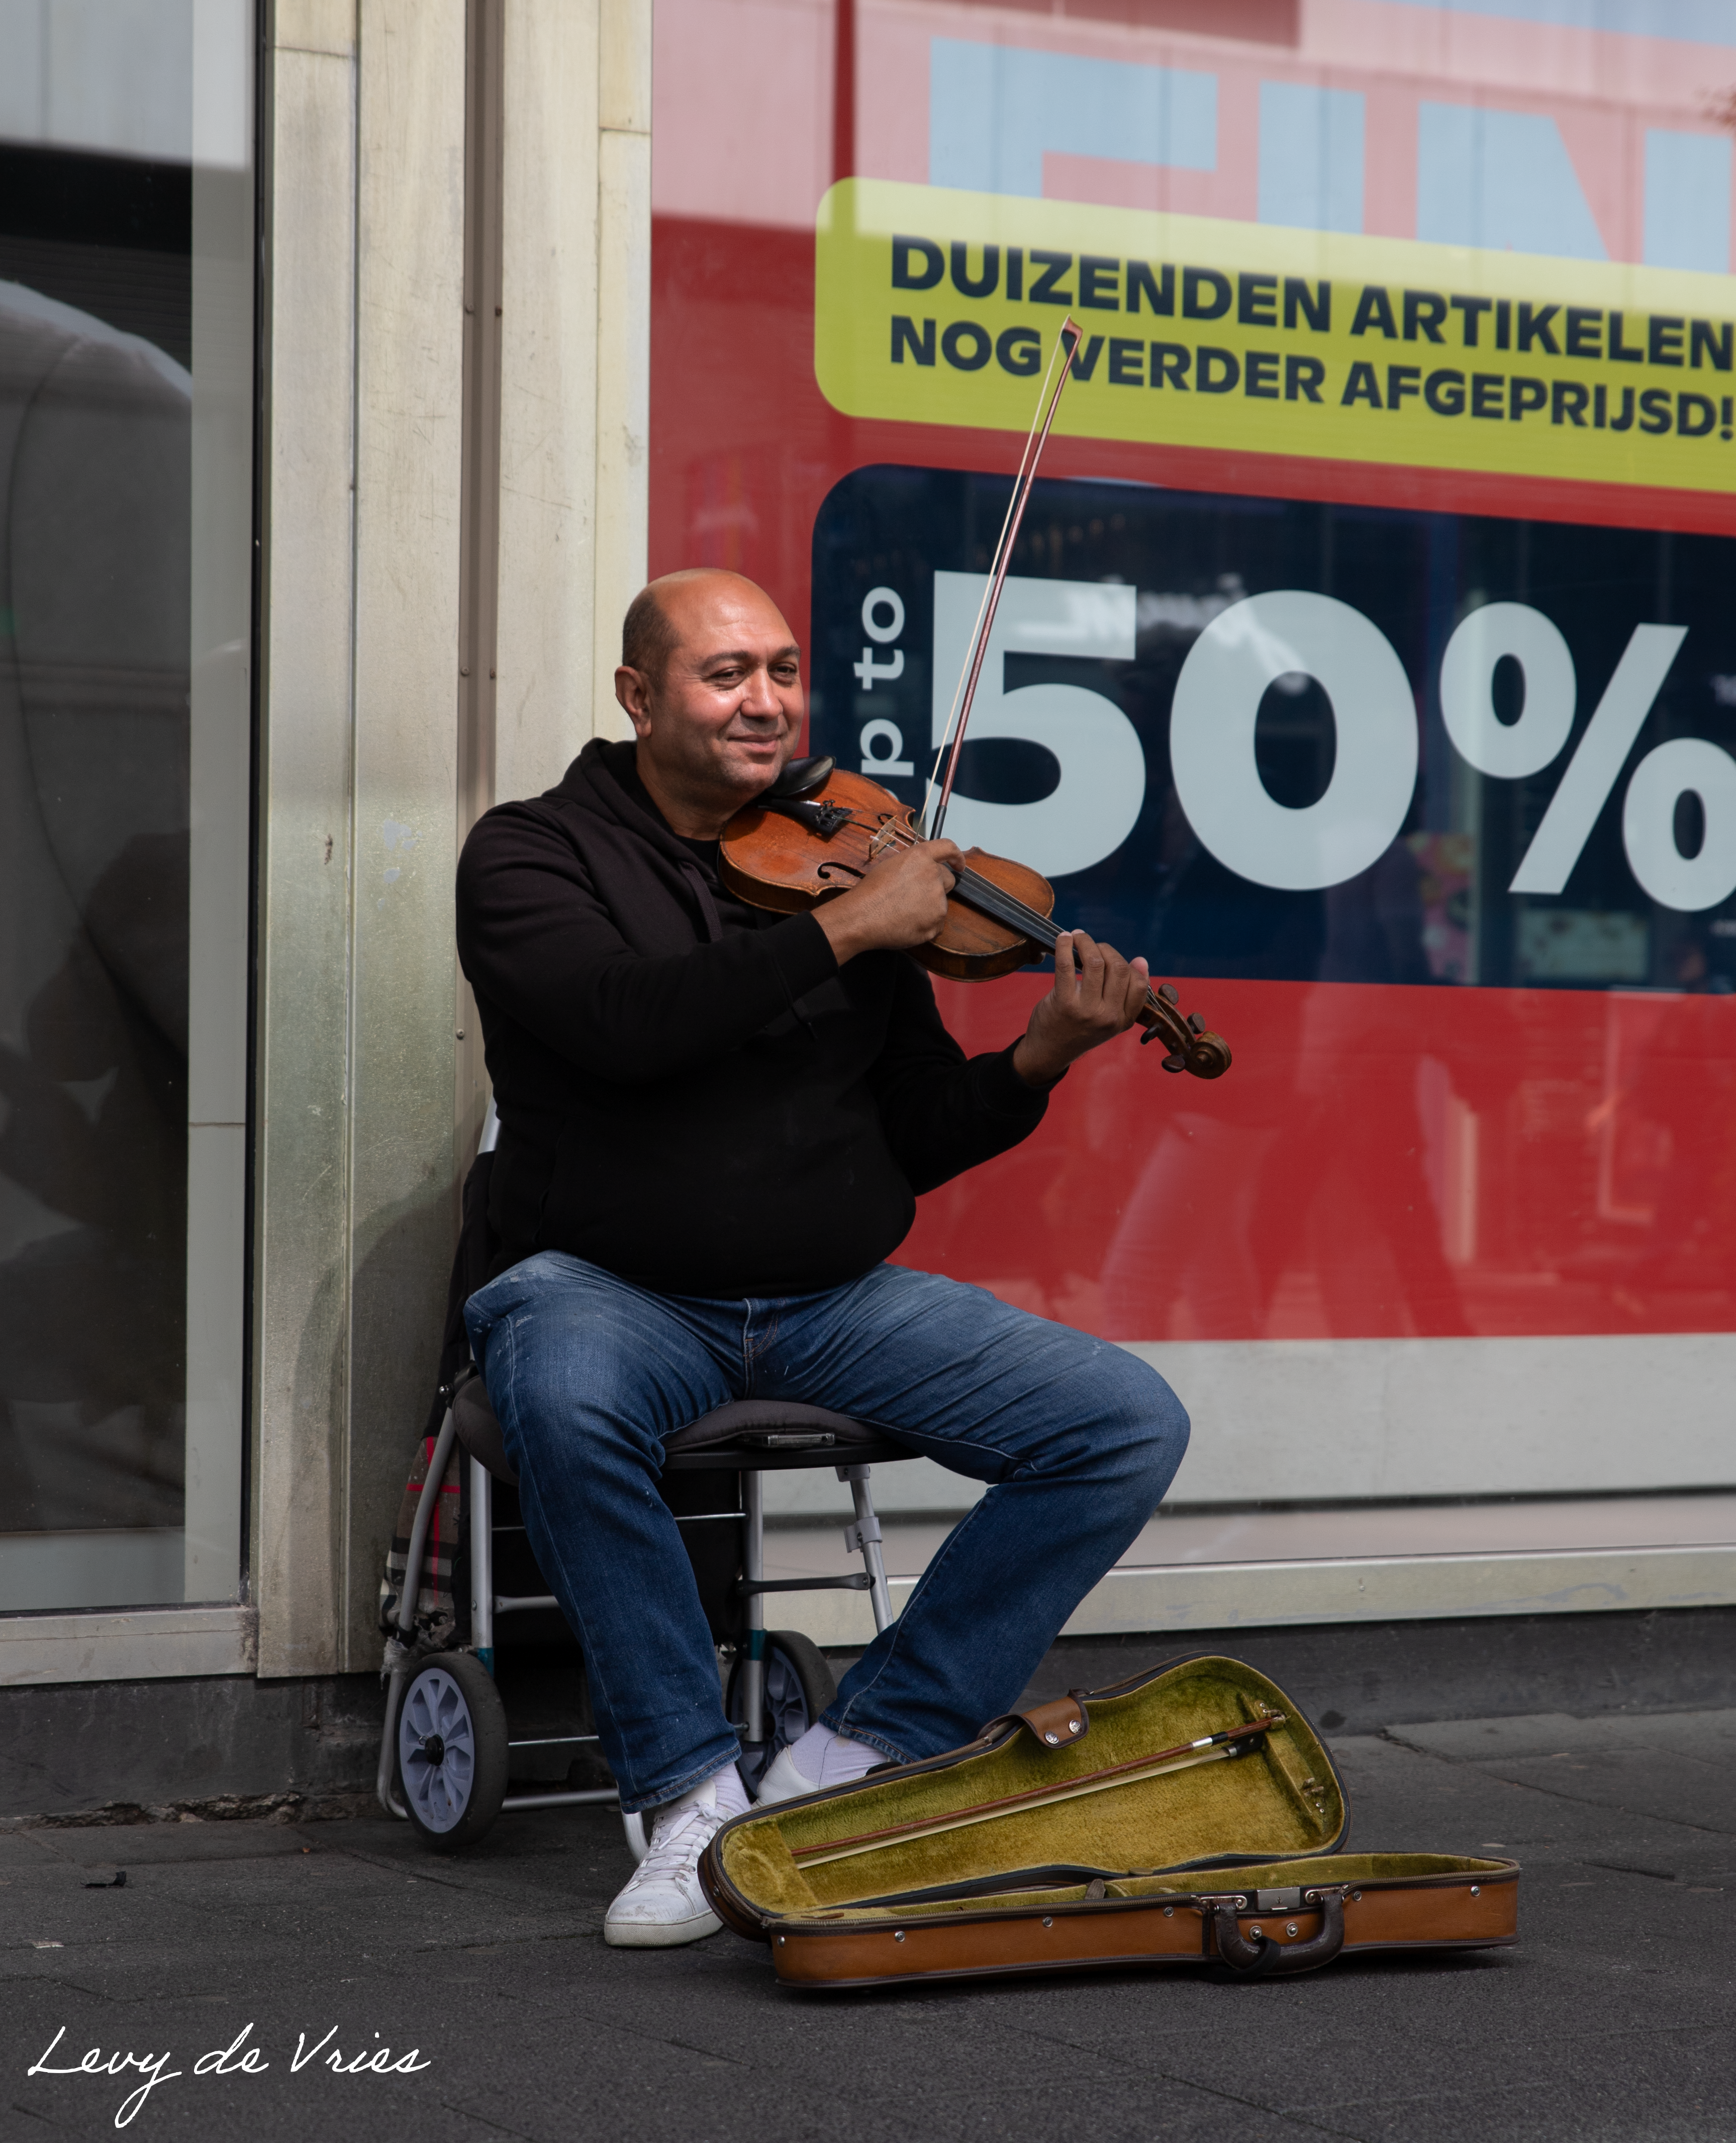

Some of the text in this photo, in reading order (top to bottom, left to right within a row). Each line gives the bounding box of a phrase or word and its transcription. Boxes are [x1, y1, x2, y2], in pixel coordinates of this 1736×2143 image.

[891, 315, 1734, 441] NOG VERDER AFGEPRIJSD!
[892, 233, 1734, 372] DUIZENDEN ARTIKELEN
[853, 586, 914, 800] p to
[926, 570, 1736, 911] 50%
